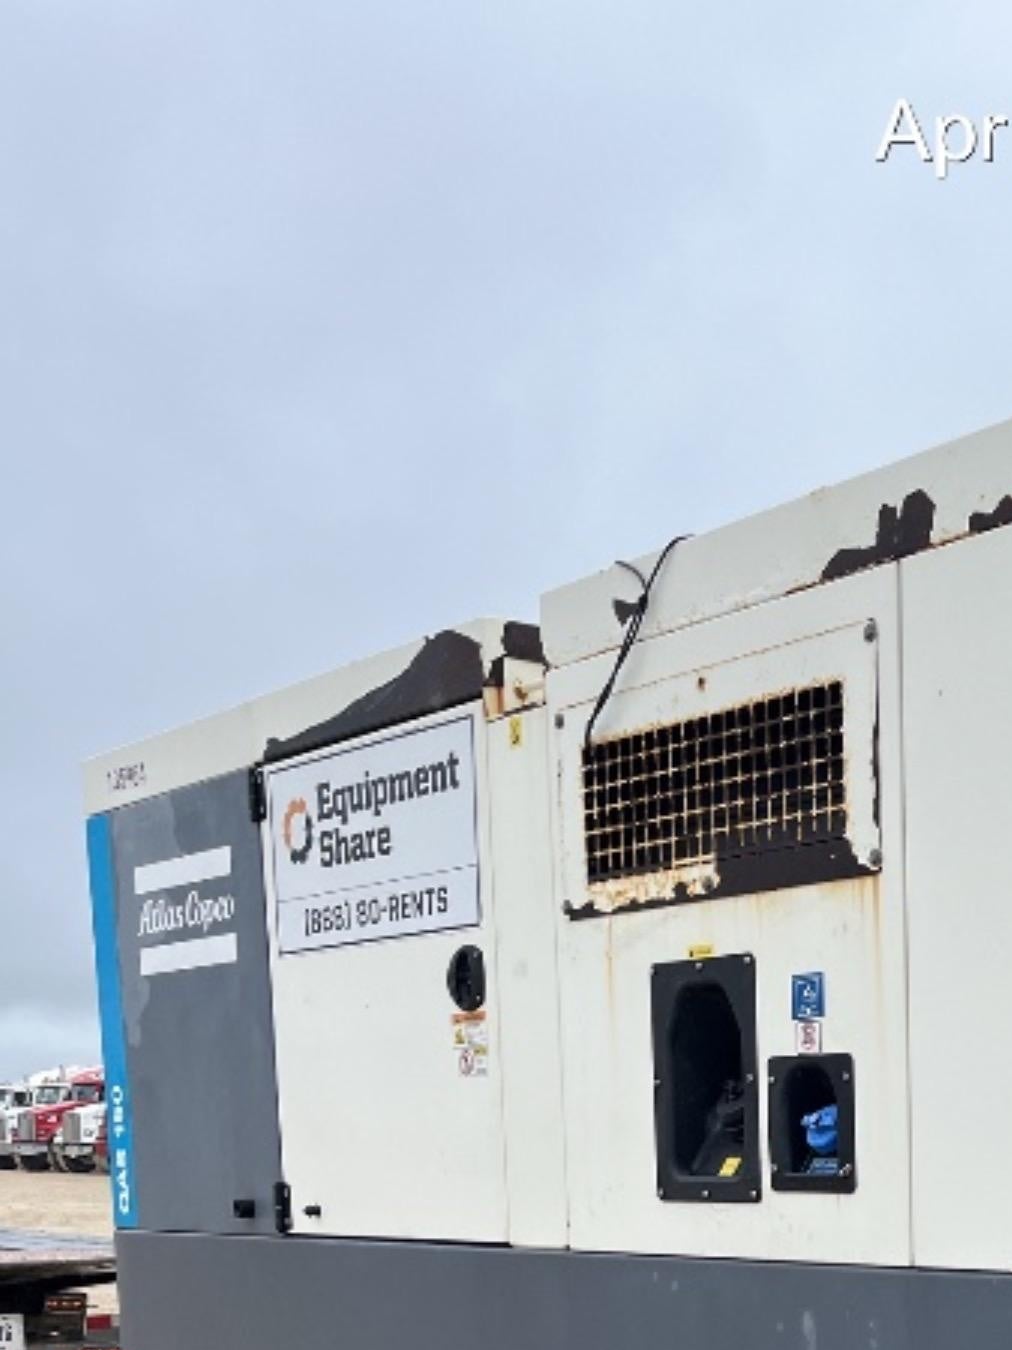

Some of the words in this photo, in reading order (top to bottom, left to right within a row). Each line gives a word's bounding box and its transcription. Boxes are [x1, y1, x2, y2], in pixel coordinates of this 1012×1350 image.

[316, 751, 460, 825] Equipment
[319, 826, 392, 868] Share
[137, 899, 184, 936] Atlas
[185, 890, 235, 934] Copco
[356, 886, 449, 928] 80-RENTS
